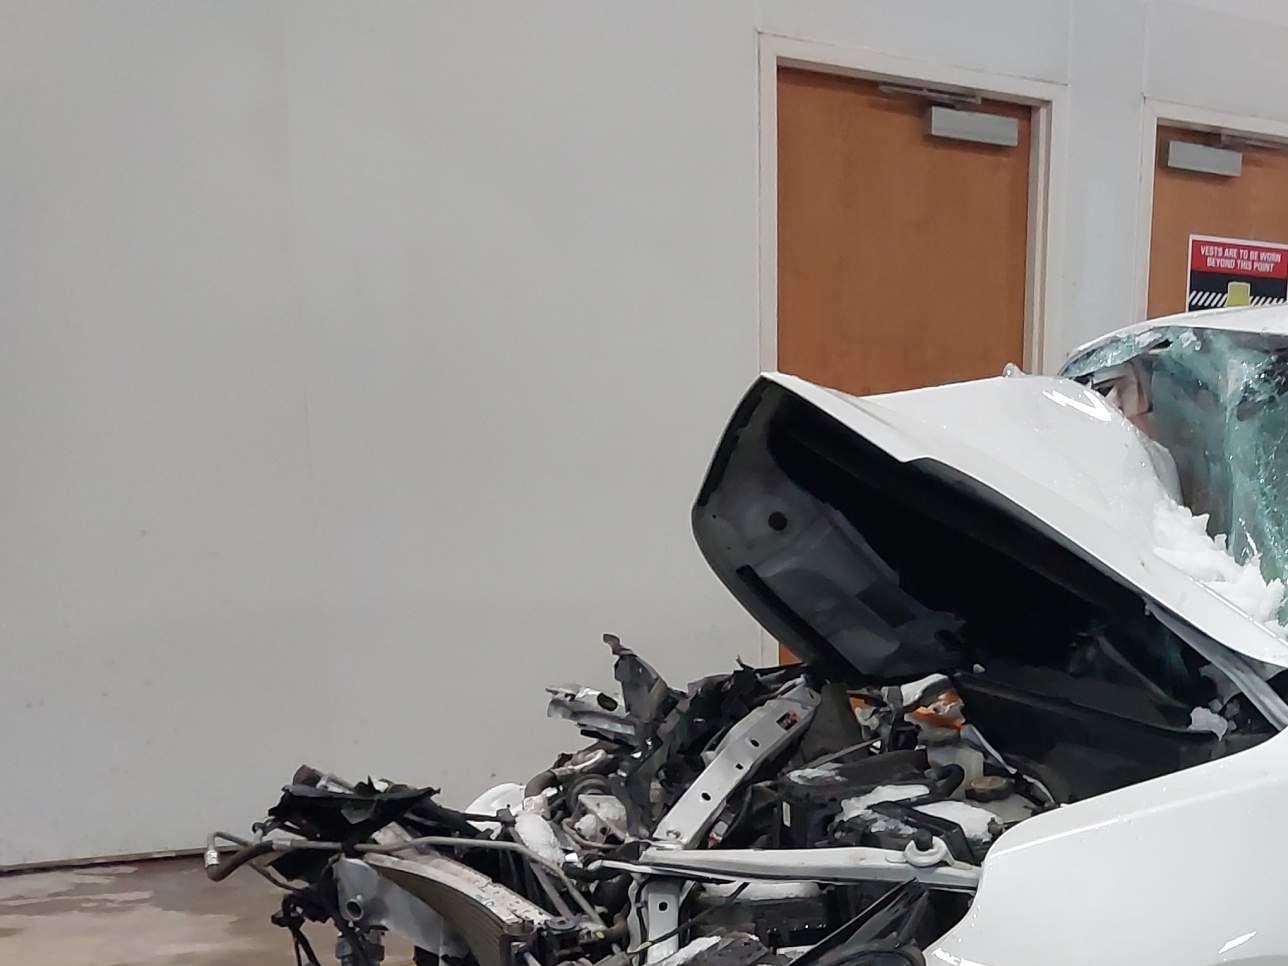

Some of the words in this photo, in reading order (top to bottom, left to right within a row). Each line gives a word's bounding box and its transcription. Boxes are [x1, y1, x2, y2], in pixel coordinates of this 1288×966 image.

[1200, 245, 1222, 257] VESTS
[1224, 248, 1237, 259] ARE
[1240, 249, 1249, 260] TO
[1250, 251, 1258, 261] BE
[1206, 257, 1235, 269] BEYOND
[1237, 260, 1252, 271] THIS
[1253, 262, 1274, 273] POINT
